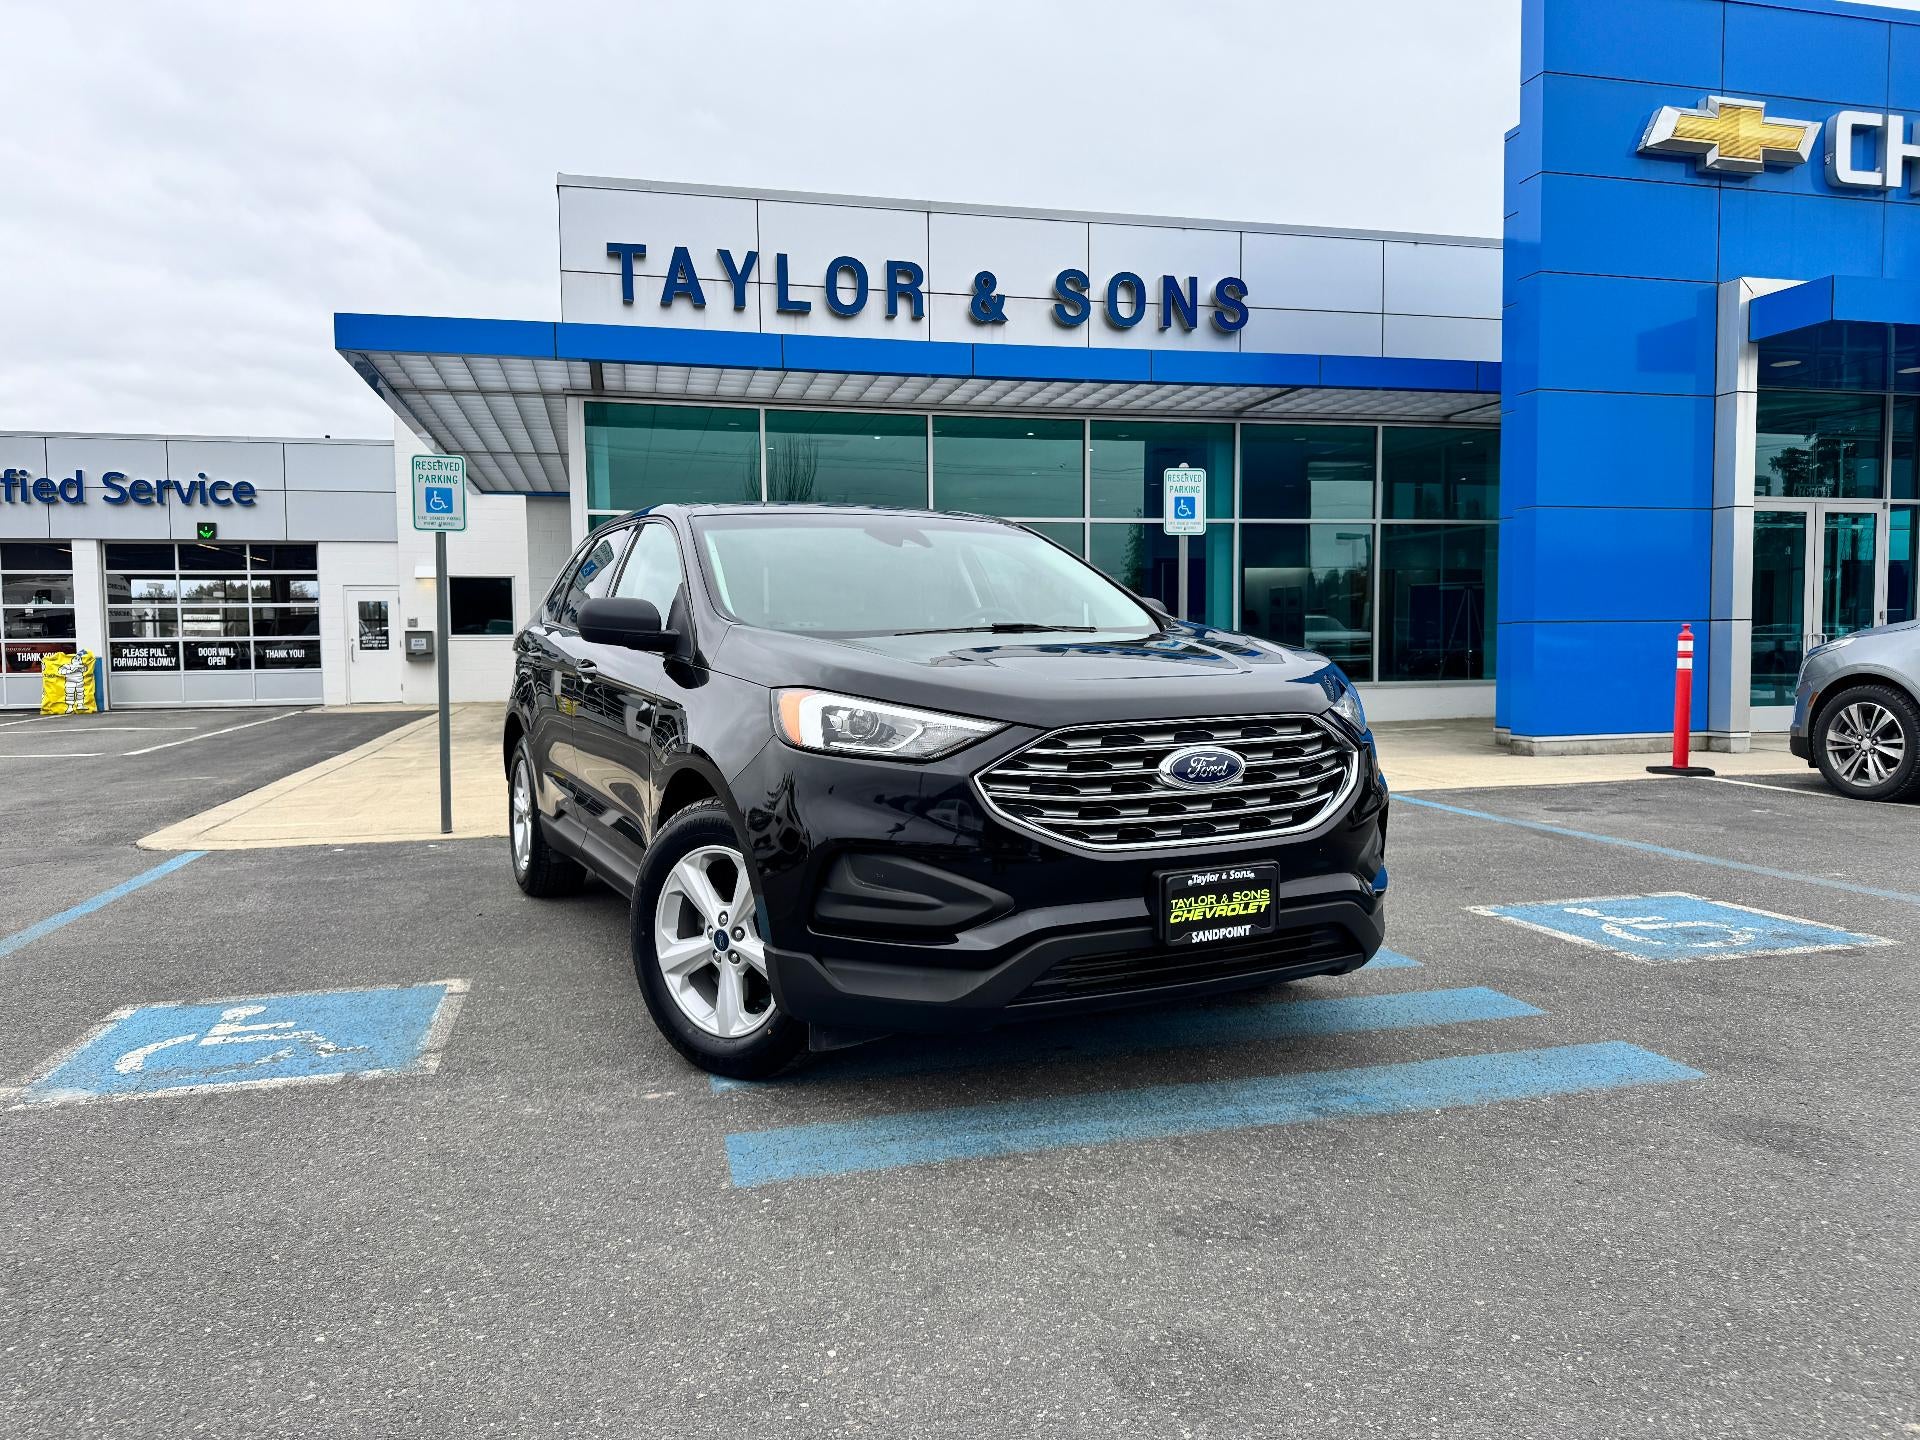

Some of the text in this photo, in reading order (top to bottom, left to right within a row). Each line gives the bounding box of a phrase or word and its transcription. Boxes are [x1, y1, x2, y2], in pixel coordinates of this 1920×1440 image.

[606, 242, 1250, 333] TAYLOR & SONS
[415, 460, 460, 471] RESERVED
[418, 473, 458, 485] PARKING
[1167, 474, 1202, 483] RESERVED
[101, 471, 257, 506] Service
[1169, 485, 1201, 494] PARKING
[16, 652, 41, 661] THANK
[122, 648, 167, 657] PLEASE PULL
[198, 647, 234, 656] DOOR WILL
[265, 649, 305, 658] THANK YOU!
[113, 657, 176, 667] FORWARD SLOWLY
[207, 656, 227, 665] OPEN
[1186, 755, 1229, 778] Ford
[1191, 869, 1251, 885] Taylor & Sons
[1171, 888, 1270, 909] TAYLOR & SONS
[1169, 900, 1271, 924] CHEVROLET
[1191, 924, 1252, 943] SANDPOINT
